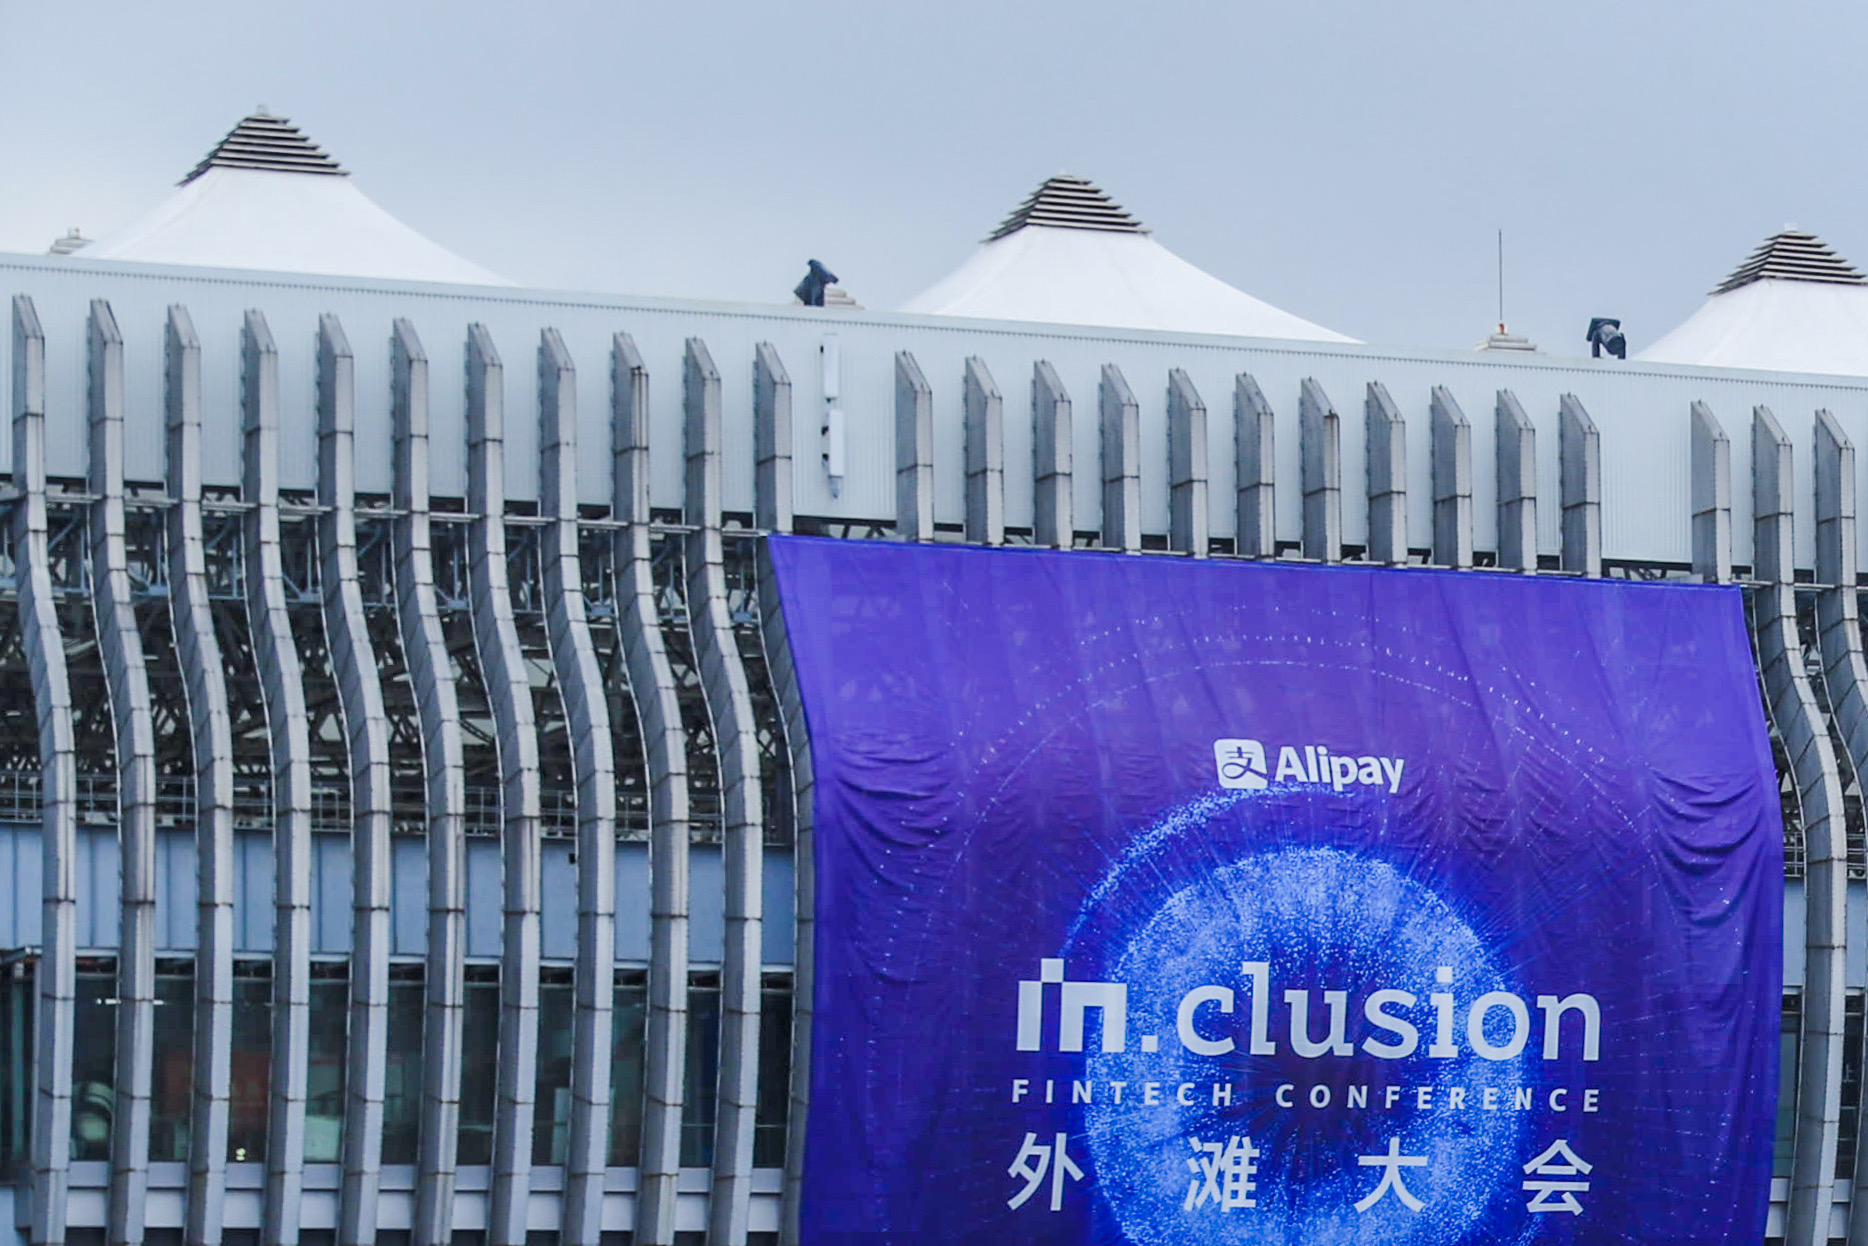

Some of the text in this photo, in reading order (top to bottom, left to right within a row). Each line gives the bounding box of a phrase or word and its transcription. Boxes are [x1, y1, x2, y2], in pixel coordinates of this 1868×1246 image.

[1275, 745, 1404, 795] Alipay
[1016, 957, 1602, 1062] in.clusion
[1012, 1078, 1600, 1113] FINTECH CONFERENCE
[1007, 1133, 1595, 1217] 外滩大会
